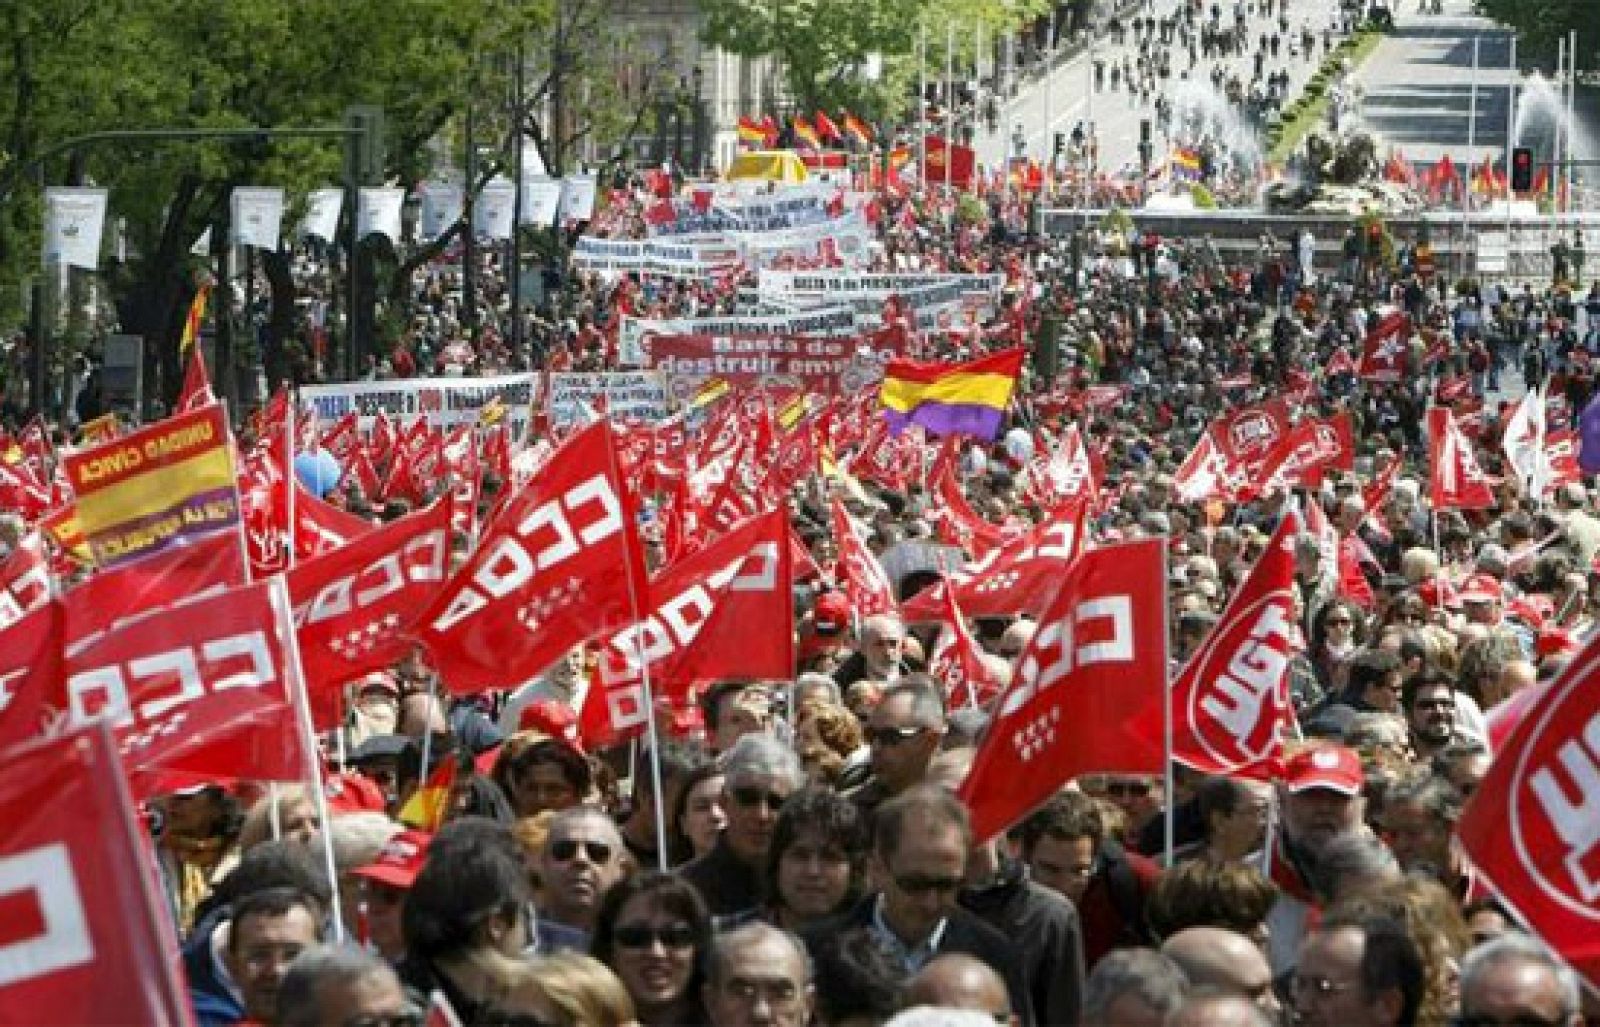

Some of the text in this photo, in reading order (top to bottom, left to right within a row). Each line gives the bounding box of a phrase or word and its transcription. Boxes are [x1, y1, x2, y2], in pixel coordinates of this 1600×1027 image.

[711, 336, 843, 355] Basta de
[657, 353, 782, 375] destruir
[1200, 602, 1307, 739] UGT
